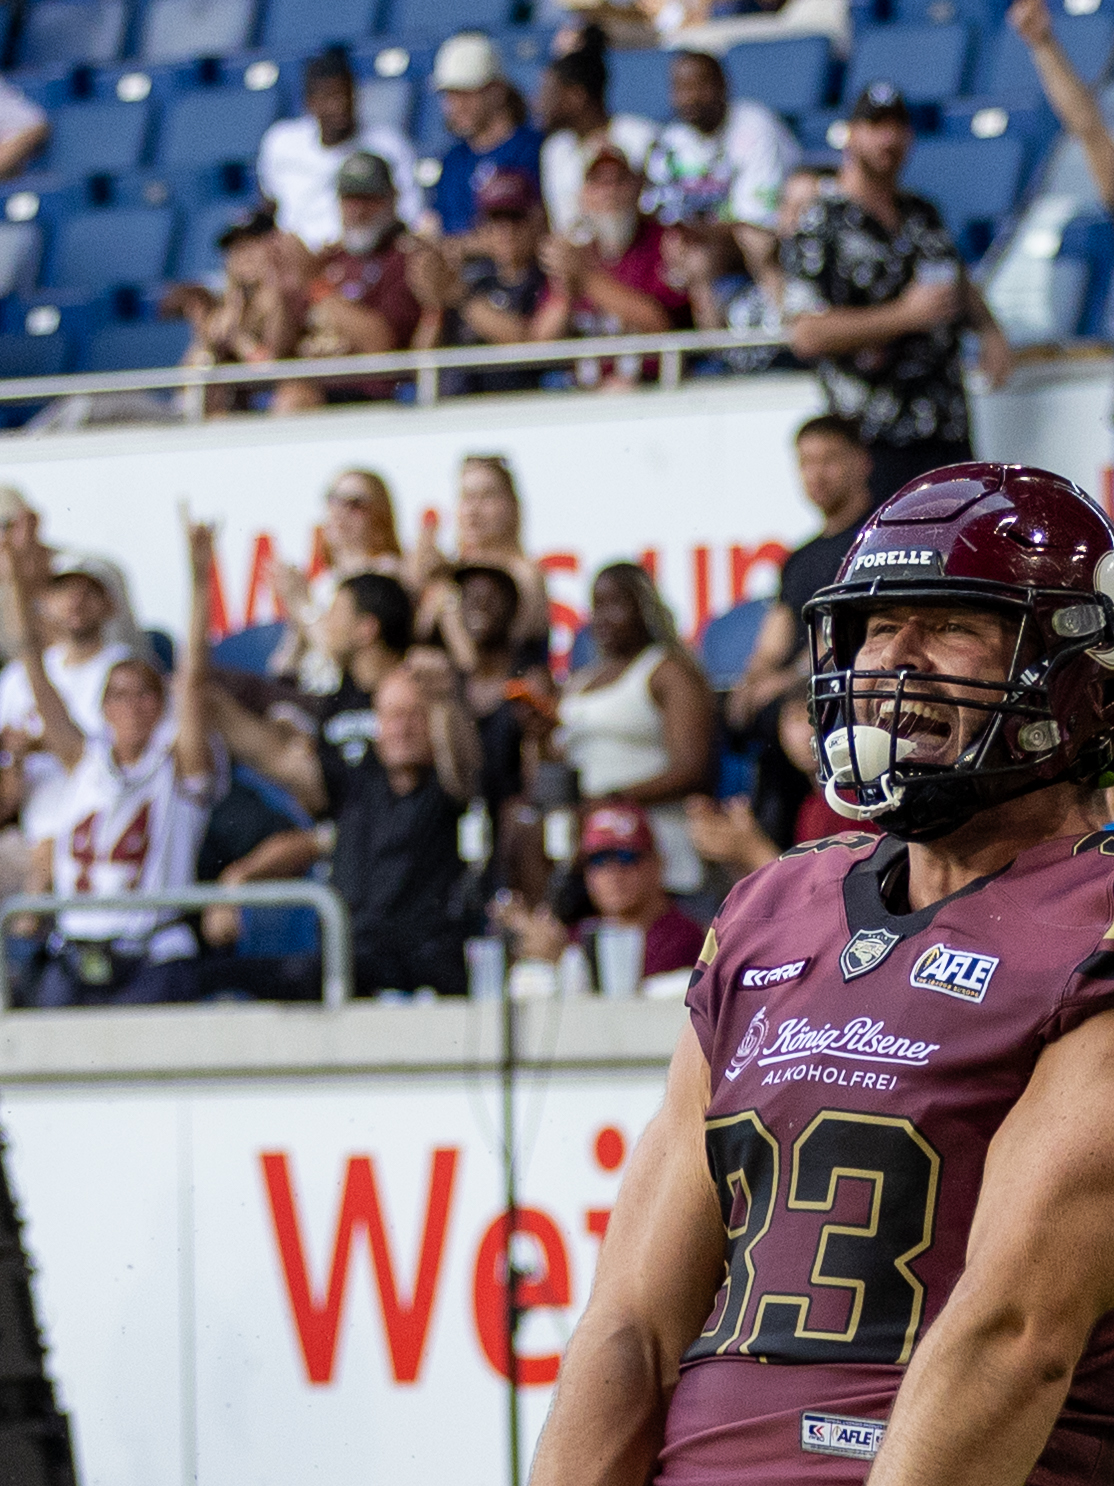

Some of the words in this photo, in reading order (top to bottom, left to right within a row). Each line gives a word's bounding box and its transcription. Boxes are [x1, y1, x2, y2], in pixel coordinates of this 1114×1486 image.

[855, 551, 933, 571] FORELLE
[920, 952, 992, 990] AFLE
[763, 1018, 838, 1056] König
[837, 1017, 940, 1060] Pilsener
[761, 1064, 897, 1091] ALKOHOLFREI
[837, 1428, 873, 1446] AFLE
